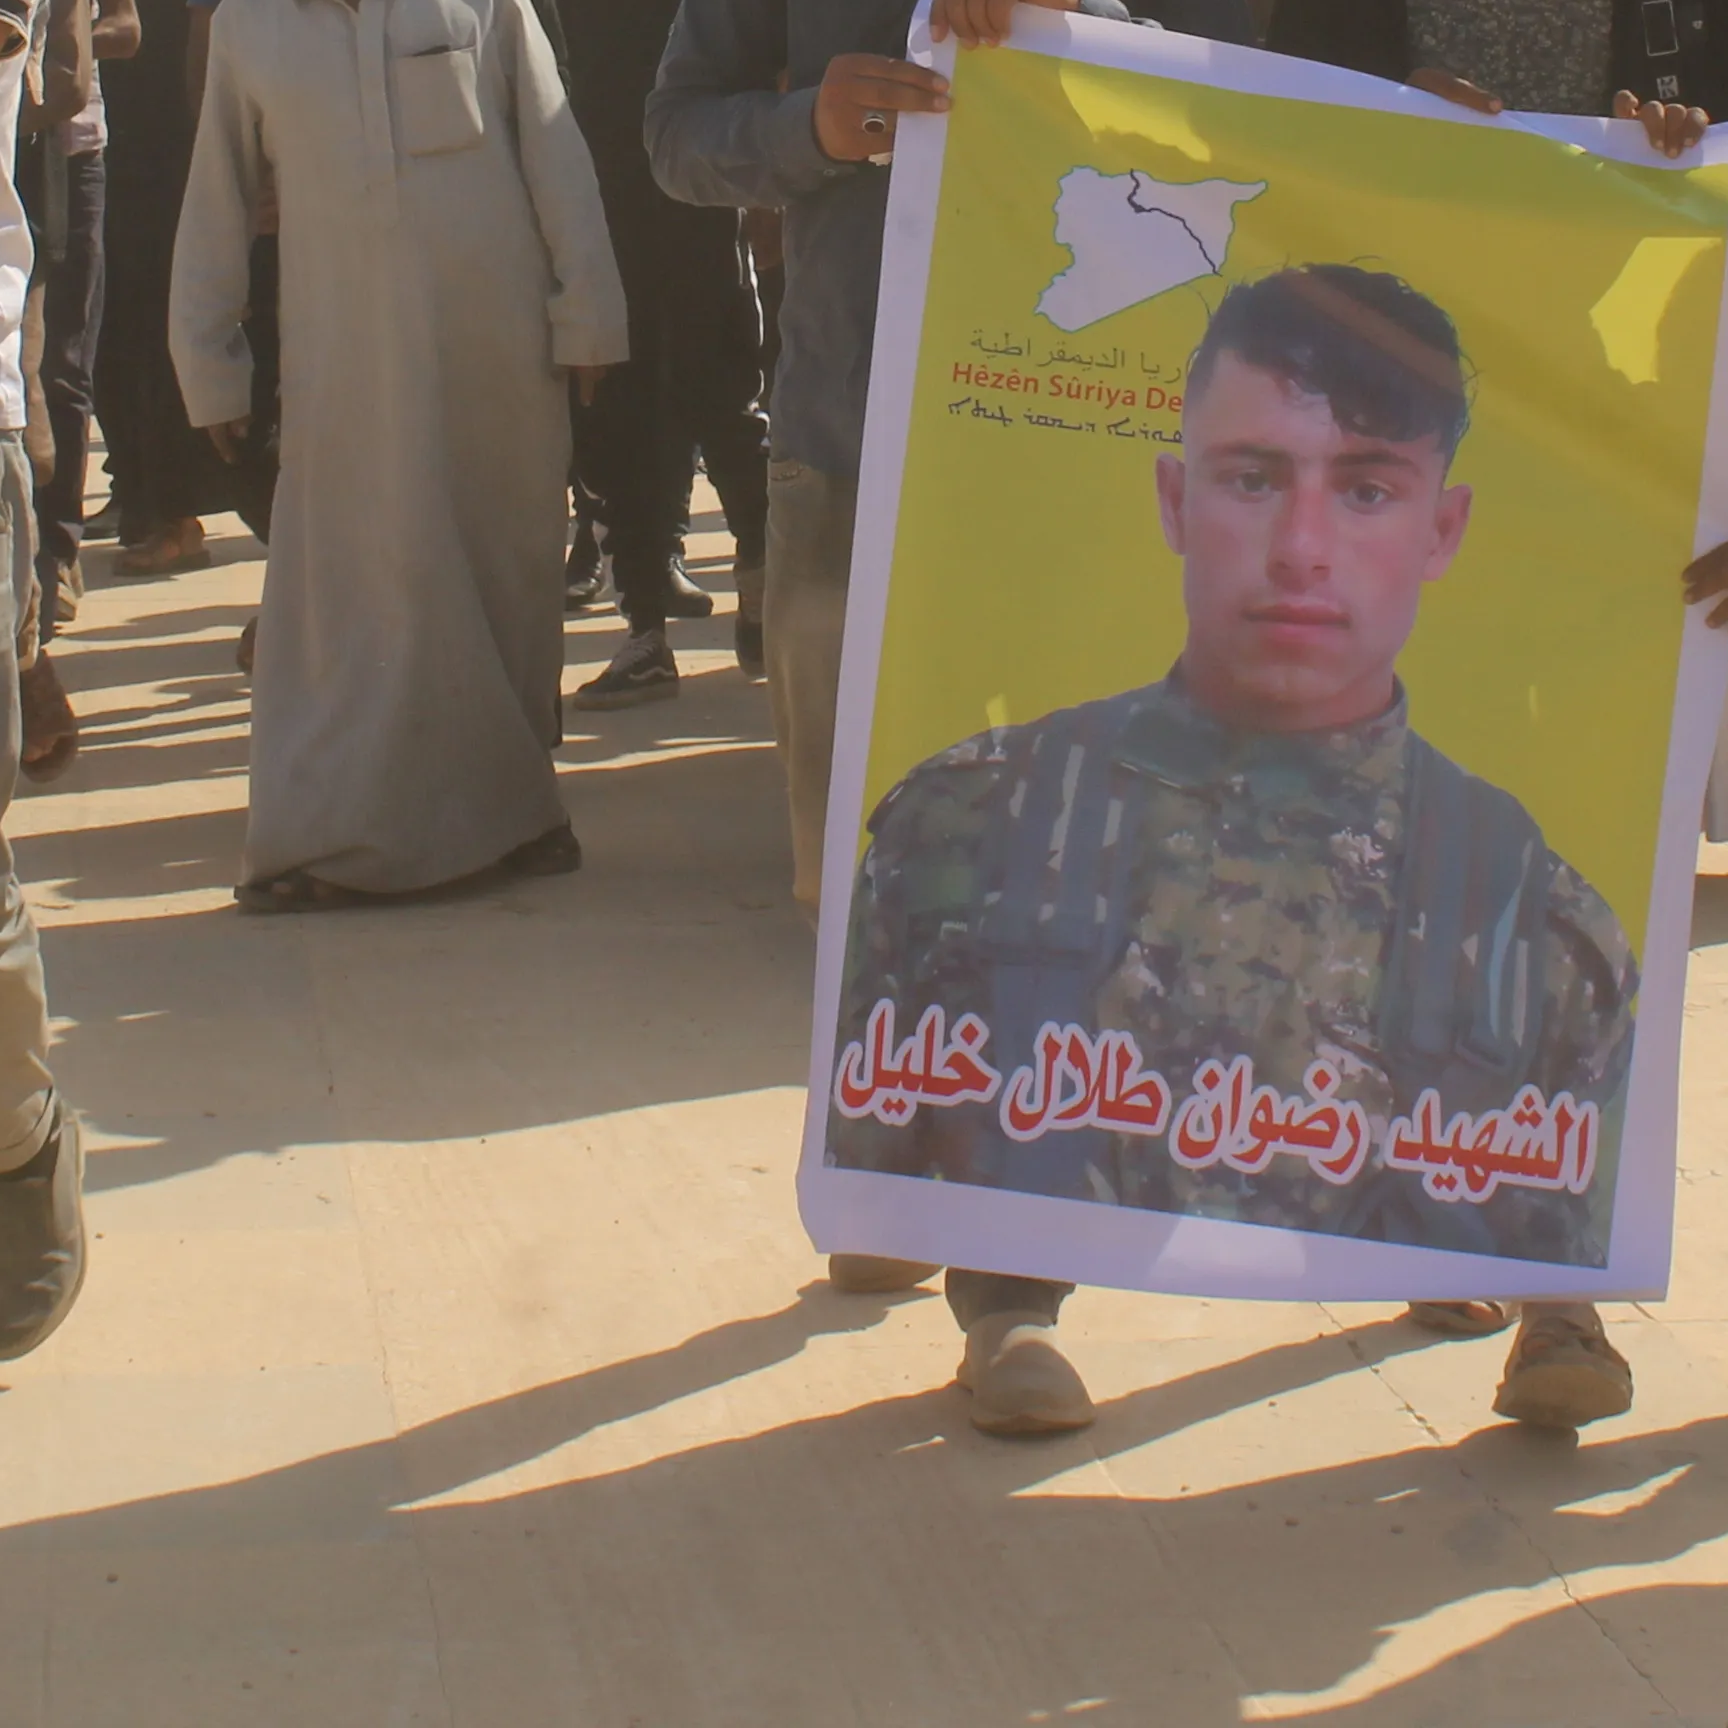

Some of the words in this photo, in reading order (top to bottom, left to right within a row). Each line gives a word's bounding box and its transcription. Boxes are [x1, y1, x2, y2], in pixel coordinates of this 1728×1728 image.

[952, 362, 1040, 395] Hêzên
[1048, 374, 1136, 410] Sûriya
[833, 999, 1001, 1121] خليل
[1000, 1020, 1170, 1140] طلال
[1169, 1055, 1370, 1184] رضوان
[1385, 1085, 1599, 1201] الشهيد
